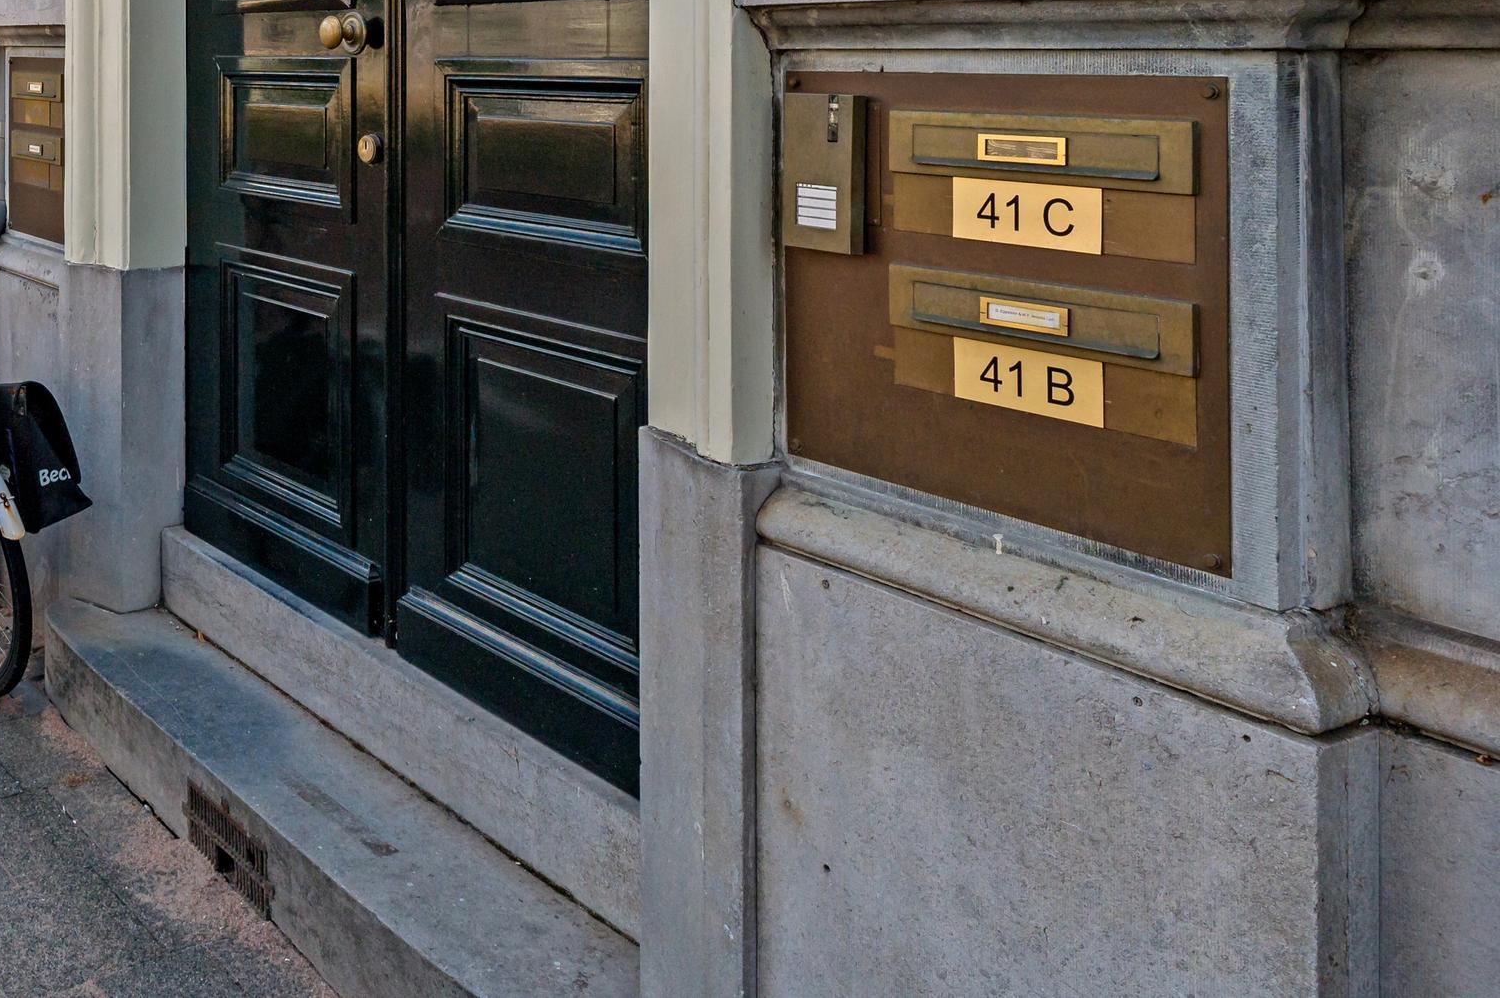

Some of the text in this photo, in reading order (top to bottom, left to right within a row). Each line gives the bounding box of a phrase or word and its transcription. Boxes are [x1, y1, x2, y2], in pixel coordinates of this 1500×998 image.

[977, 192, 1074, 236] 41 C
[980, 356, 1075, 406] 41 B
